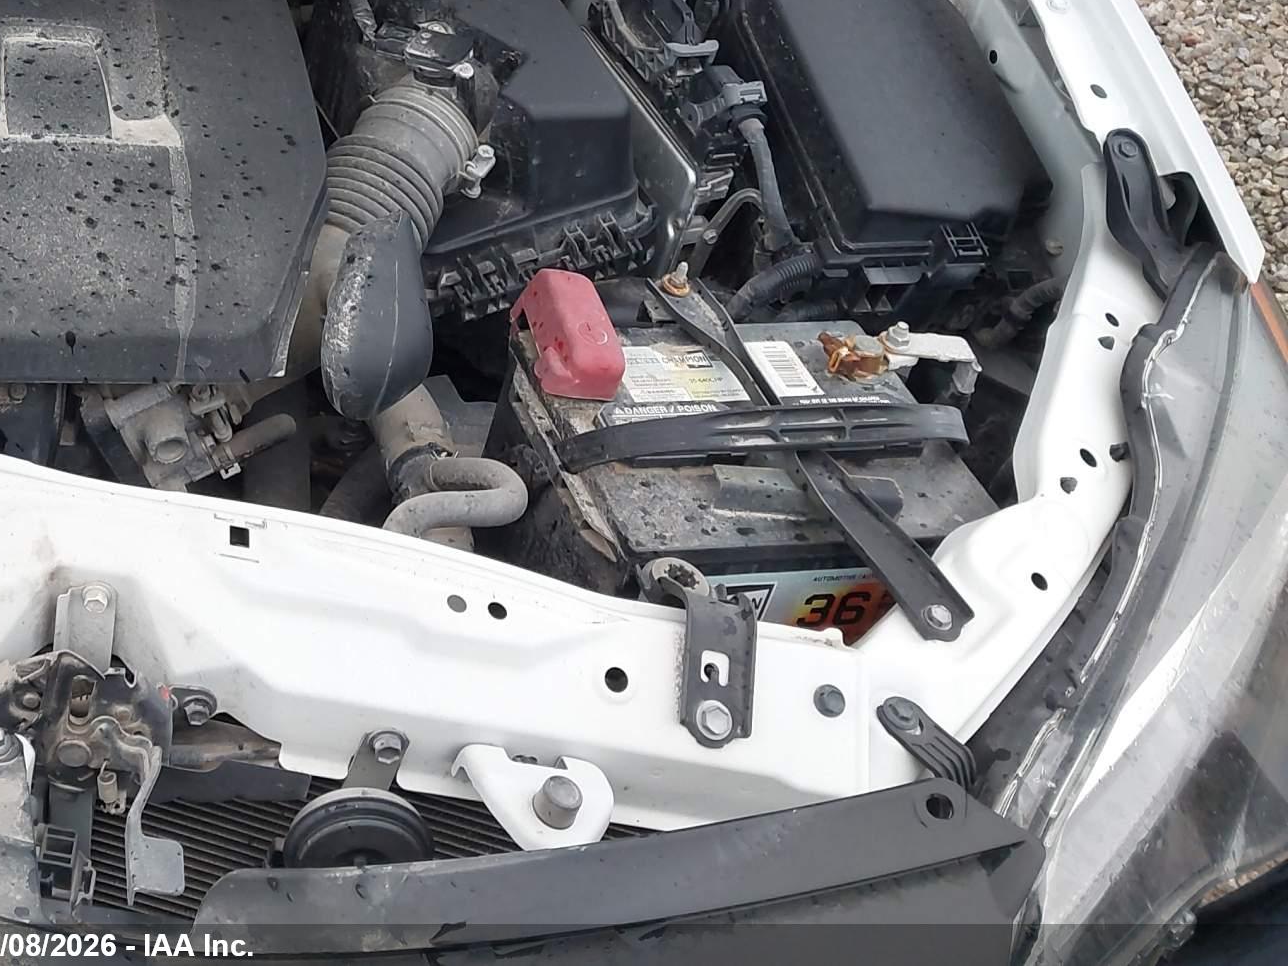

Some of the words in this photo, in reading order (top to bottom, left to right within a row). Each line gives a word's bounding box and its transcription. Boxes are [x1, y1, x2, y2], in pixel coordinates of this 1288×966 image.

[661, 353, 707, 366] CHAMPION
[623, 405, 668, 415] DANGER
[678, 403, 717, 413] POISON
[796, 591, 872, 628] 36
